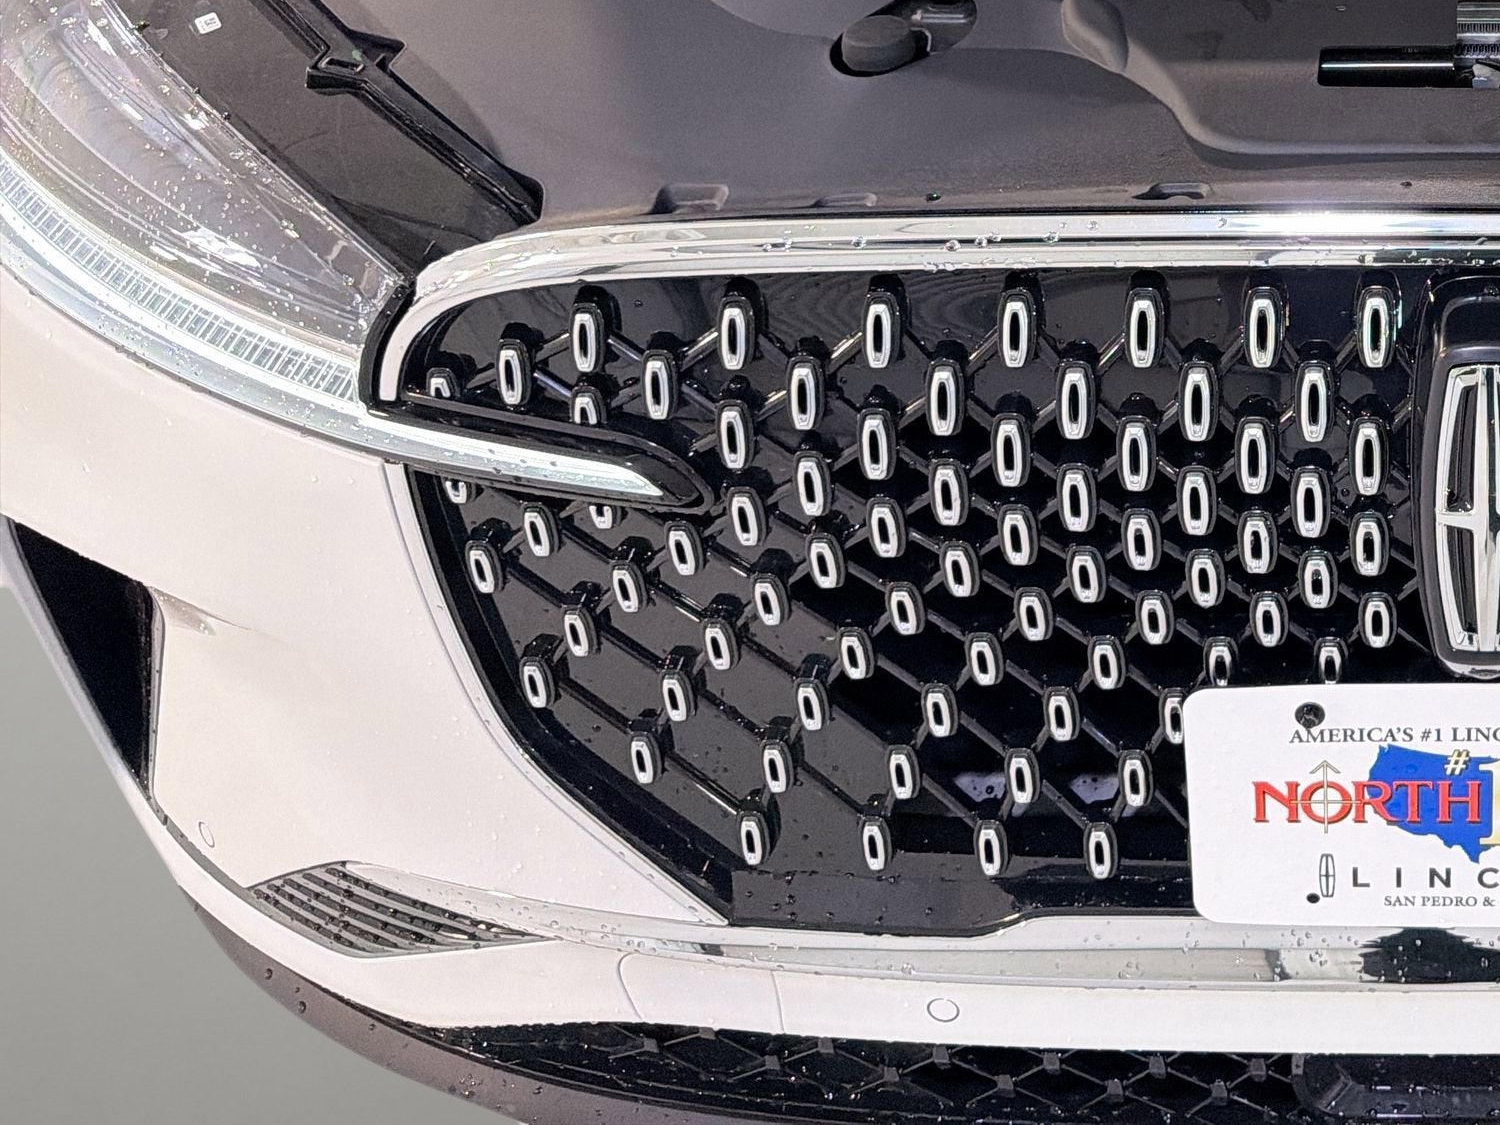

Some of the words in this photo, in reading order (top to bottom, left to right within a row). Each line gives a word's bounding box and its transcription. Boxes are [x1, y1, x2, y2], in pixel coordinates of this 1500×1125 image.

[1289, 727, 1414, 744] AMERICA'S
[1421, 728, 1443, 742] #1
[1252, 779, 1482, 824] NORTH
[1384, 896, 1416, 908] SAN
[1421, 896, 1478, 908] PEDRO
[1482, 896, 1497, 908] &
